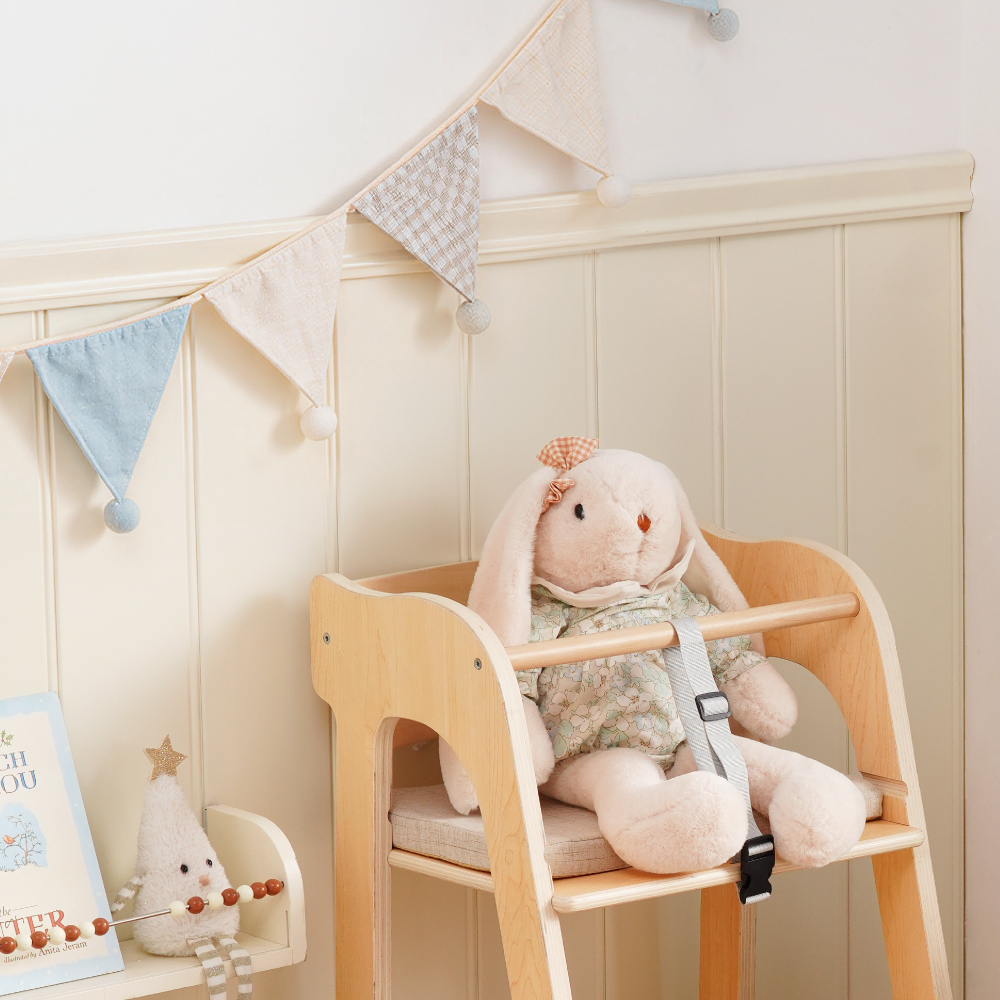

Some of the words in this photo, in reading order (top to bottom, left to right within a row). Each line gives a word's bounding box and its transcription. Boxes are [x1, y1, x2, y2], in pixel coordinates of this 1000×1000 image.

[0, 906, 12, 918] he
[38, 946, 61, 957] Anita
[62, 941, 88, 952] Jeram
